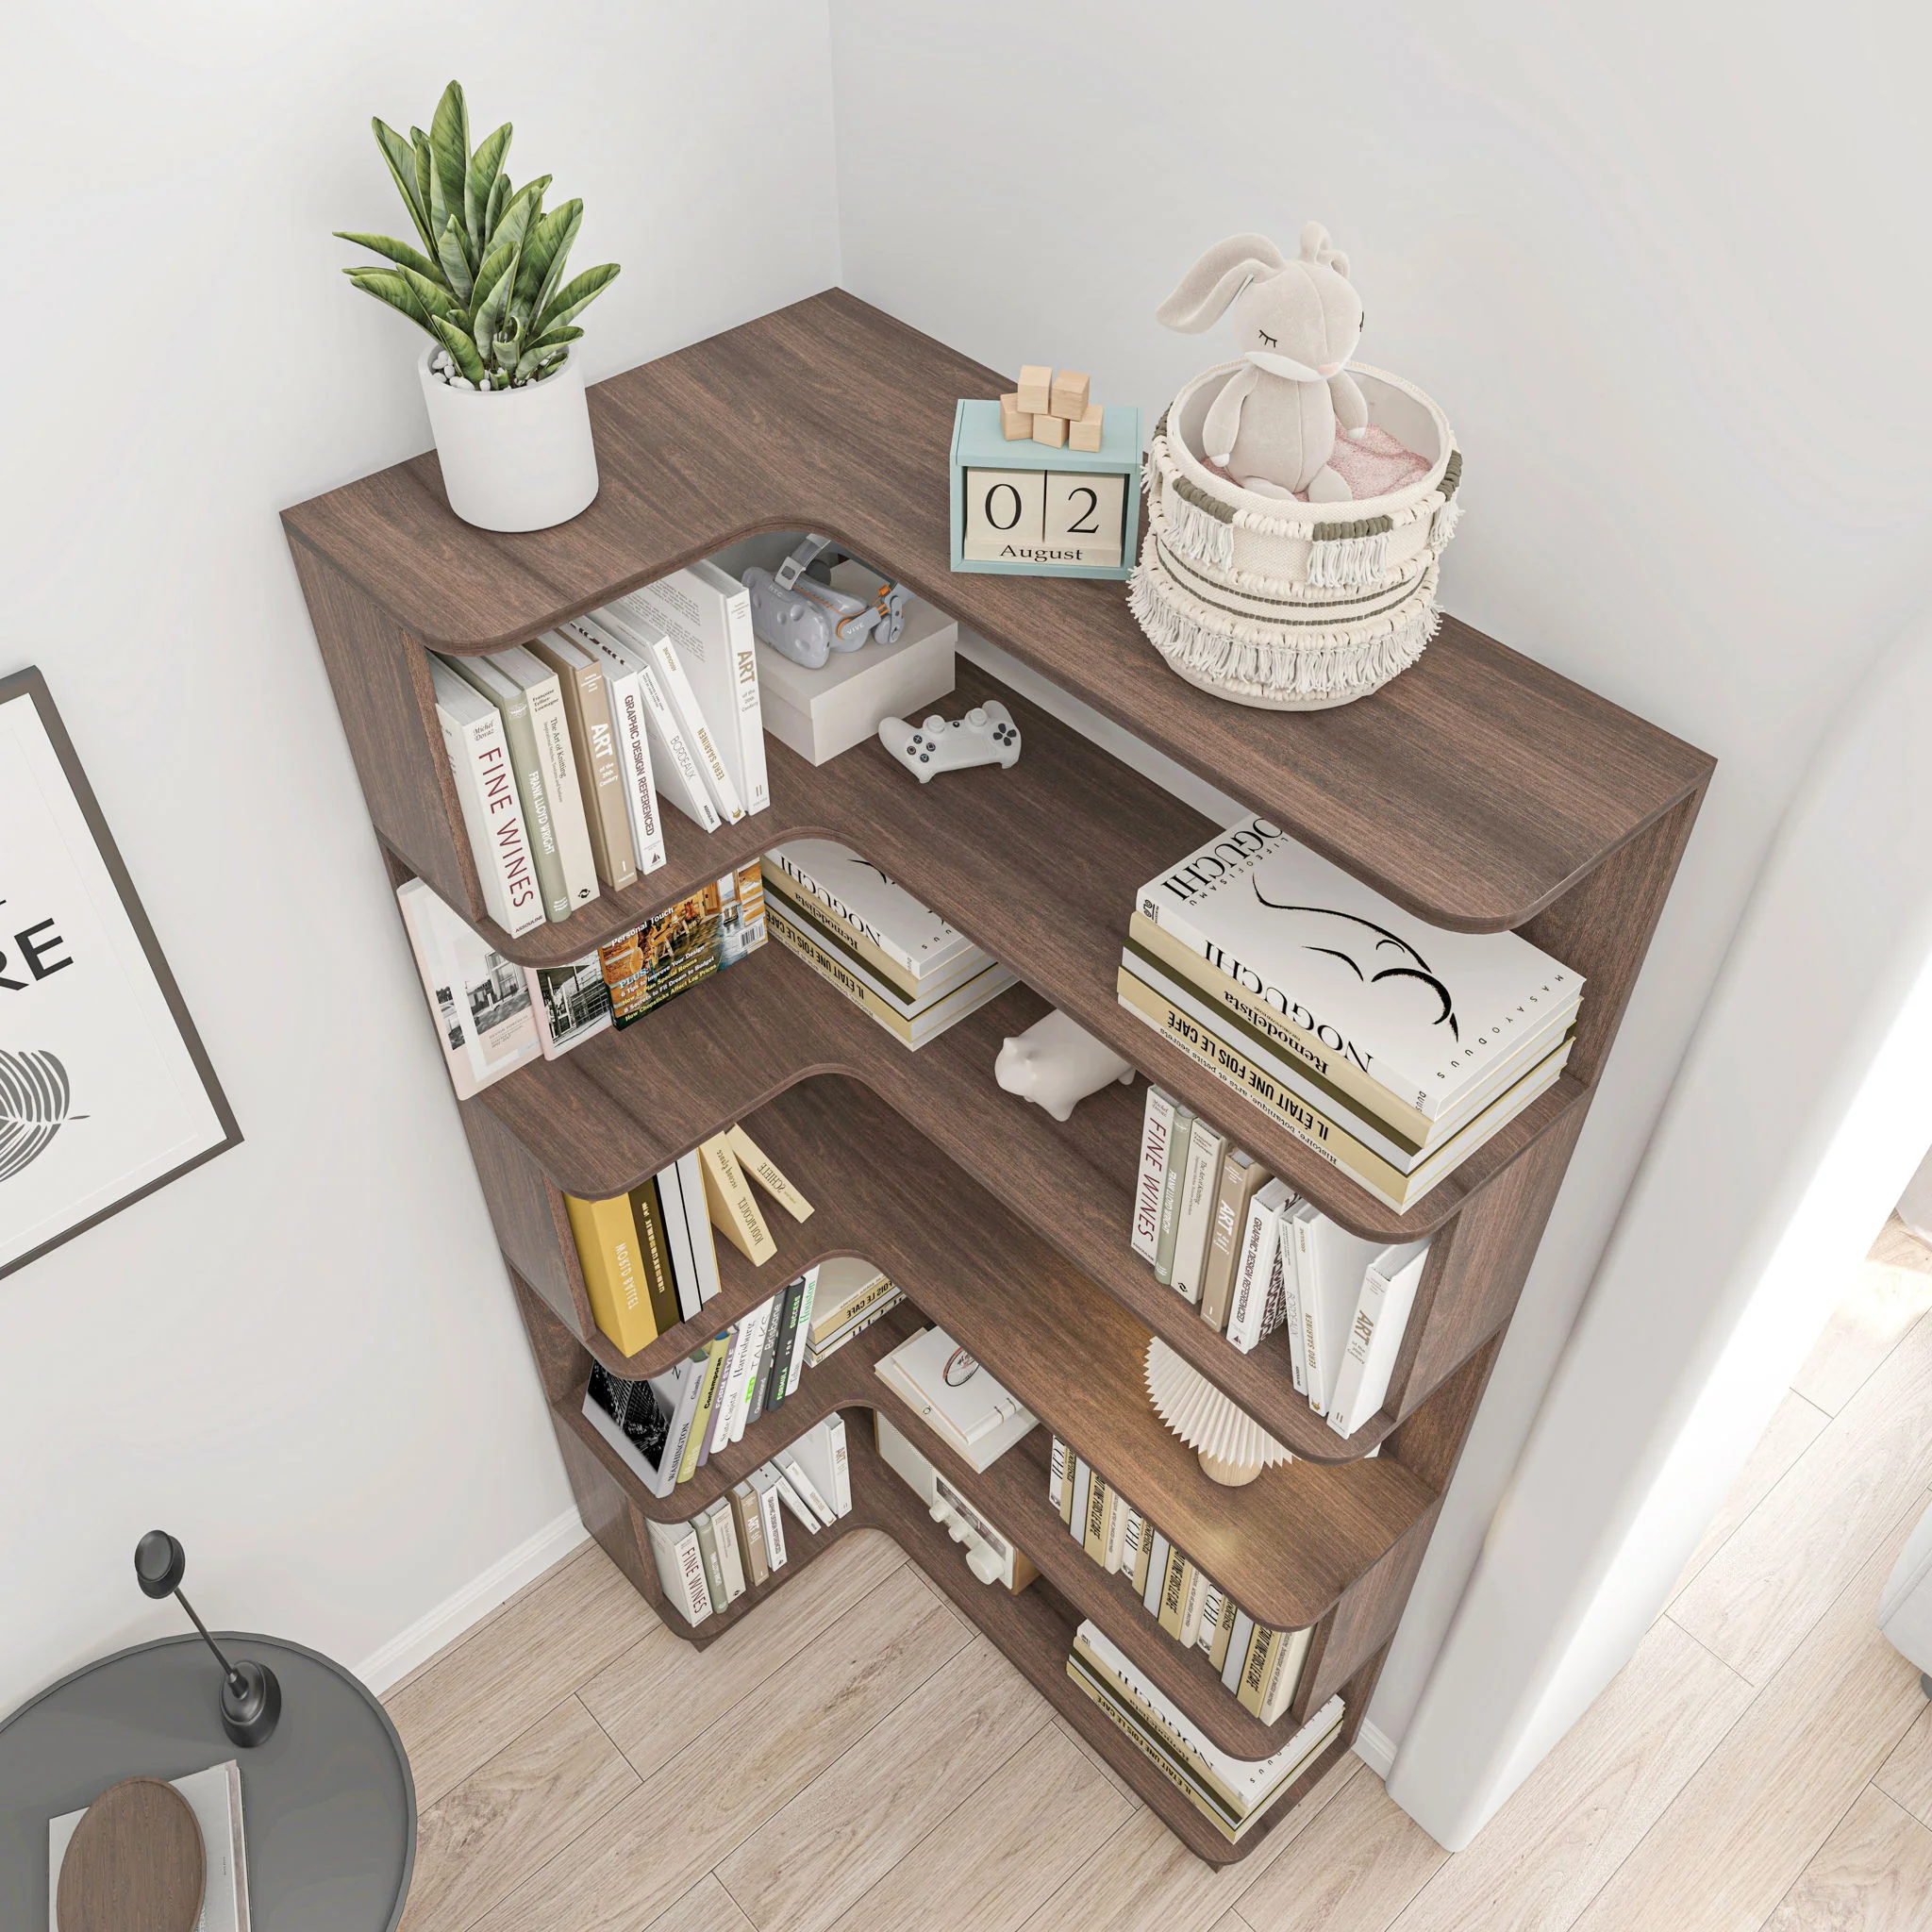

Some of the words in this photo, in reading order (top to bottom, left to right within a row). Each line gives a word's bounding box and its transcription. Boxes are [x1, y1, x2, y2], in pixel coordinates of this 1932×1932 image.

[1000, 544, 1083, 562] August
[847, 622, 865, 635] VIVE
[737, 650, 756, 684] ART
[473, 720, 494, 735] Michel
[625, 694, 640, 740] GRAPHIC
[551, 717, 559, 732] The
[558, 752, 567, 778] Knitting
[591, 724, 613, 758] ART
[632, 740, 646, 775] DESIGN
[697, 727, 717, 763] SAARINEN
[670, 736, 697, 781] BORDEAUX
[712, 761, 725, 781] EERO
[528, 770, 543, 796] FRANK
[599, 775, 619, 787] Century
[534, 795, 549, 824] LLOYD
[638, 776, 655, 836] REFERENCED
[478, 746, 512, 814] FINE
[496, 818, 534, 908] WINES
[540, 823, 555, 855] WRIGHT
[1160, 817, 1283, 901] OGUCHI
[1256, 837, 1289, 860] LIFE
[1238, 860, 1254, 874] OF
[780, 856, 881, 947] NOGUCHI
[1189, 873, 1235, 907] ISAMU
[515, 915, 543, 933] ASSOULINE
[611, 924, 648, 946] Personal
[650, 907, 675, 924] Touch
[787, 926, 795, 942] LE
[794, 892, 858, 950] Remodelista
[797, 937, 814, 958] FOIS
[816, 953, 831, 973] UNE
[619, 968, 649, 990] PLUS:
[623, 996, 635, 1006] How
[644, 982, 657, 991] Plan
[658, 969, 677, 984] Special
[678, 958, 697, 972] Rooms
[627, 985, 640, 994] Tips
[647, 965, 671, 981] Improve
[672, 957, 685, 967] Your
[686, 945, 705, 959] Design
[630, 994, 652, 1009] Secrets
[669, 974, 687, 987] Dream
[695, 957, 714, 971] Budget
[833, 966, 855, 993] ÉTAIT
[625, 1011, 639, 1022] How
[640, 993, 670, 1012] Chopsticks
[671, 982, 688, 994] Affect
[689, 975, 699, 984] Log
[700, 964, 717, 976] Prices
[857, 984, 864, 1000] IL
[1205, 940, 1374, 1074] NOGUCHI
[1491, 974, 1564, 1034] MASAYO
[1159, 1027, 1191, 1054] secrets
[1167, 1010, 1199, 1043] CAFÉ
[1224, 991, 1329, 1075] Remodelista
[1192, 1052, 1218, 1074] petits
[1201, 1036, 1217, 1056] LE
[1437, 1038, 1488, 1079] DUUS
[1217, 1071, 1227, 1081] et
[1218, 1049, 1246, 1079] FOIS
[1229, 1080, 1248, 1096] arts
[1248, 1071, 1274, 1101] UNE
[1250, 1094, 1296, 1130] botanique,
[1276, 1093, 1314, 1131] ÉTAIT
[1145, 1118, 1167, 1172] FINE
[1298, 1129, 1338, 1165] Histoire,
[1317, 1125, 1329, 1141] IL
[1138, 1174, 1160, 1241] WINES
[1218, 1200, 1235, 1236] ART
[1251, 1217, 1262, 1252] GRAPHIC
[1244, 1250, 1257, 1278] DESIGN
[799, 1280, 816, 1324] Houston
[1236, 1277, 1252, 1323] REFERENCED
[1286, 1291, 1299, 1338] BORDEAUX
[765, 1304, 781, 1350] Brisbane
[1305, 1313, 1316, 1349] SAARINEN
[1354, 1309, 1374, 1345] ART
[733, 1321, 755, 1377] Harrisburg
[715, 1381, 726, 1408] FORM
[723, 1349, 734, 1380] STYLE
[745, 1375, 756, 1403] TED
[776, 1367, 789, 1400] FORMULA
[720, 1420, 729, 1442] State
[725, 1391, 738, 1421] Capital
[668, 1423, 690, 1481] WASHINGTON
[836, 1446, 847, 1463] ART
[682, 1546, 699, 1577] FINE
[689, 1574, 708, 1614] WINES
[1117, 1718, 1126, 1728] LE
[1126, 1727, 1143, 1745] FOIS
[1144, 1747, 1160, 1763] UNE
[1182, 1786, 1191, 1795] IL
